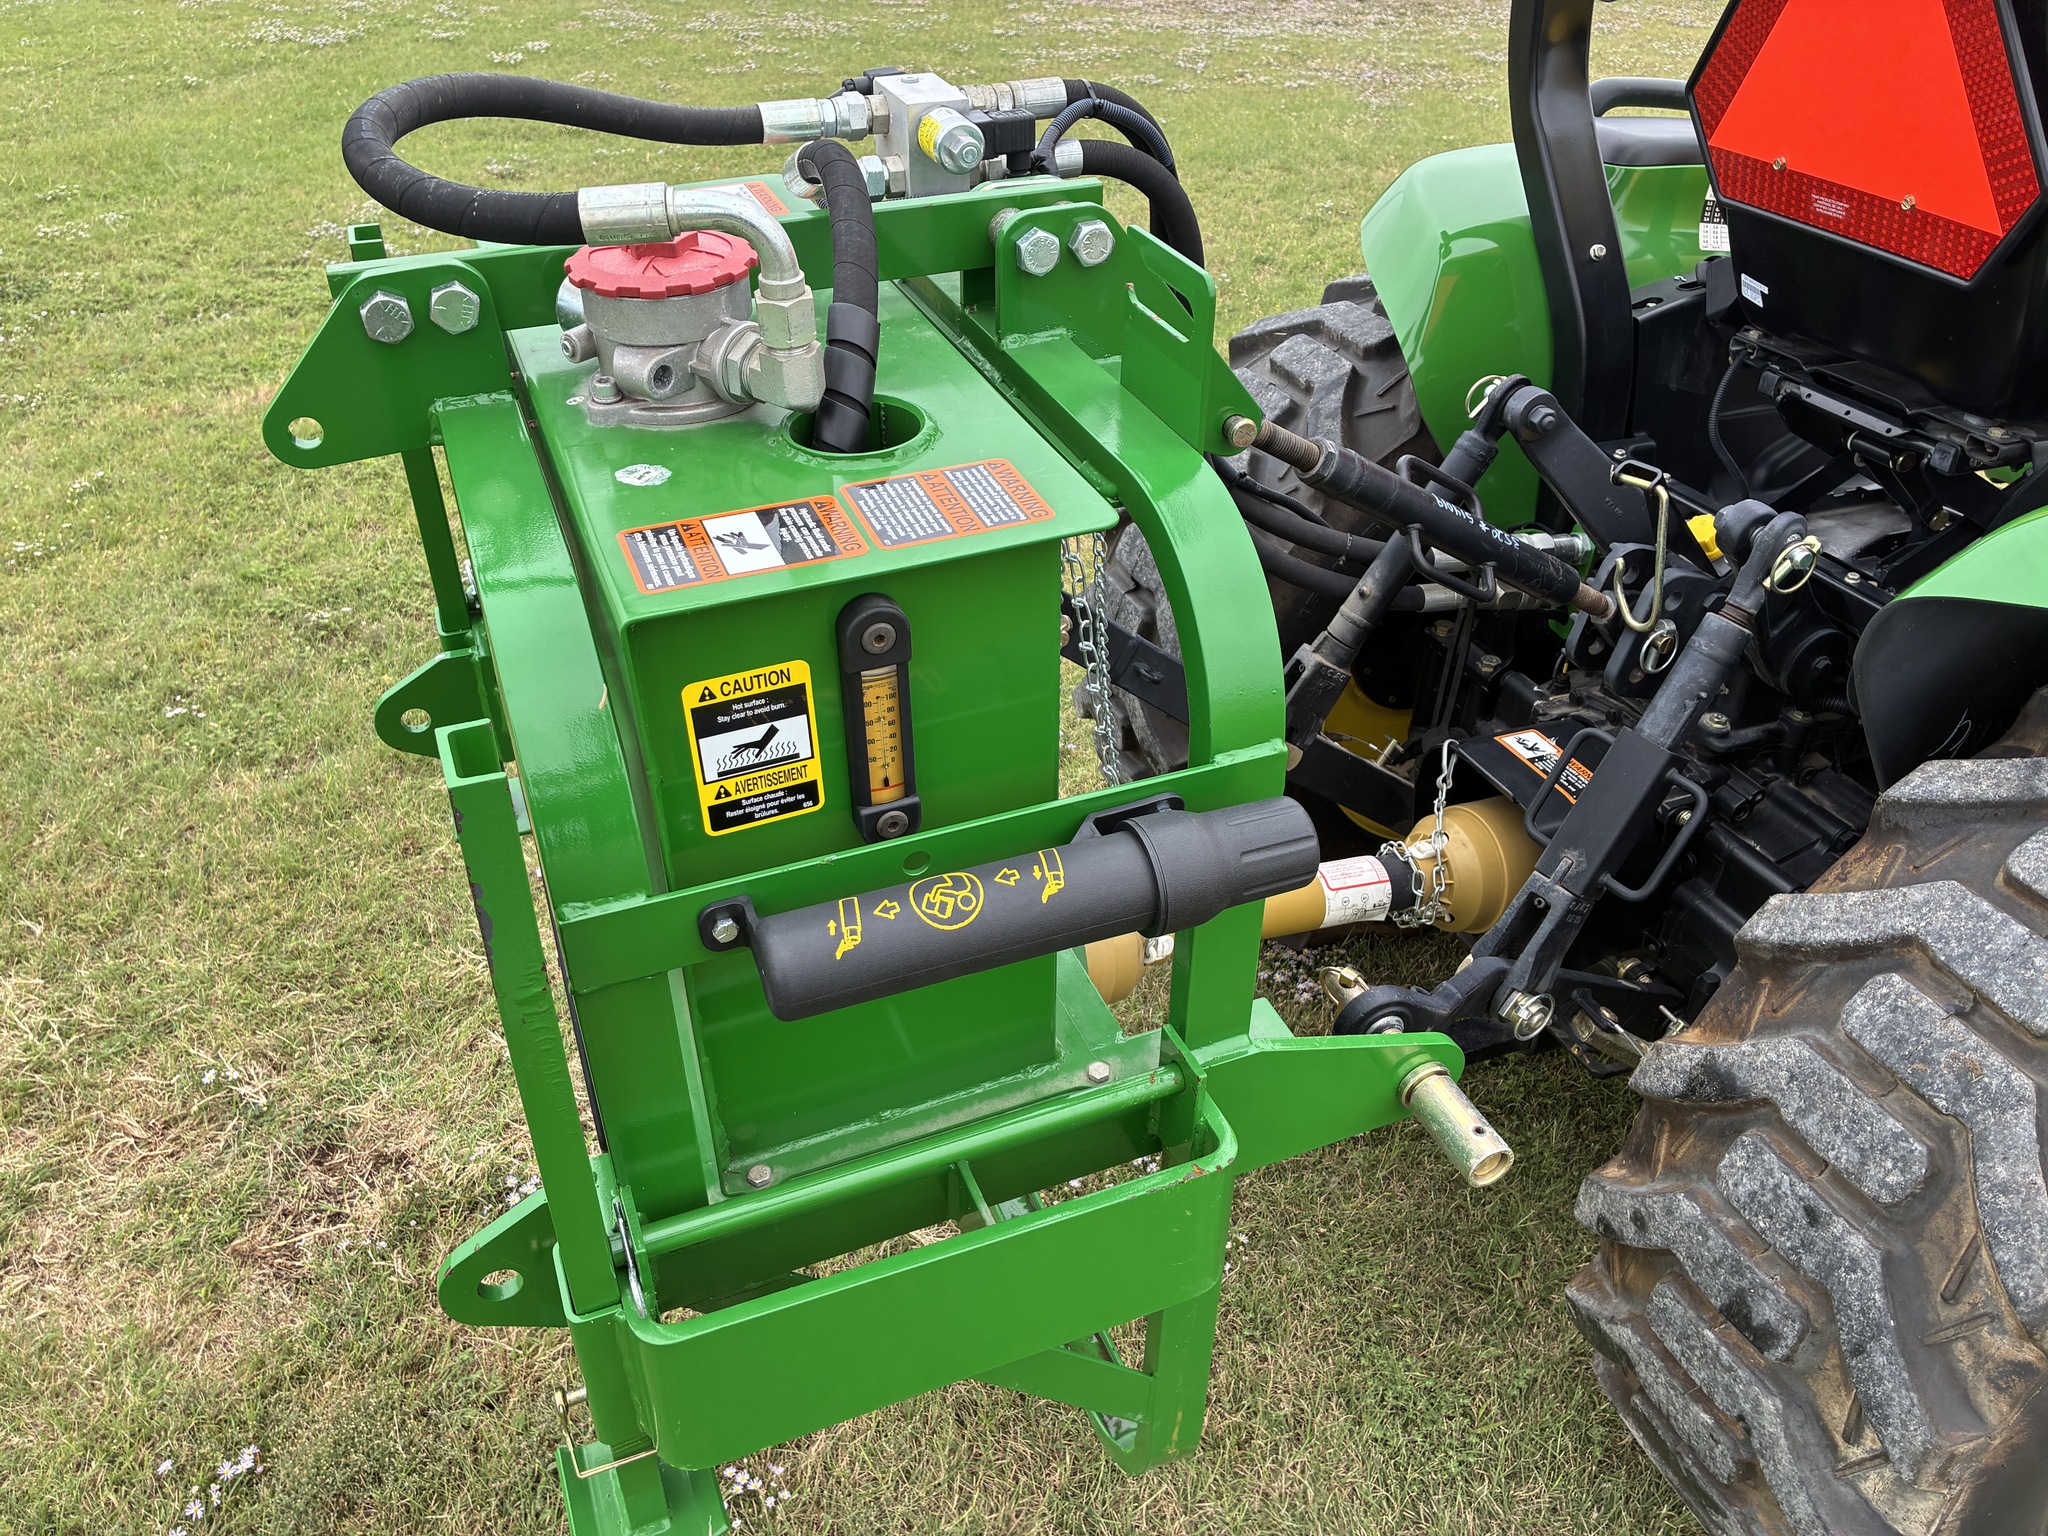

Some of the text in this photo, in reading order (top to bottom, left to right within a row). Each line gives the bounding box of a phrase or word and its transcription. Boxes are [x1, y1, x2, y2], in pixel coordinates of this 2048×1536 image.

[994, 468, 1050, 518] WARNING
[926, 480, 980, 532] ATTENTION
[818, 506, 862, 551] WARNING
[684, 530, 722, 579] ATTENTION
[720, 668, 791, 696] CAUTION
[732, 703, 743, 711] Hot
[744, 698, 765, 708] surface
[885, 692, 897, 701] 100
[717, 715, 730, 723] Stay
[731, 711, 746, 719] clear
[754, 705, 770, 714] avoid
[735, 765, 808, 795] AVERTISSEMENT
[726, 809, 744, 818] Rester
[745, 804, 766, 813] éloigné
[781, 796, 796, 805] éviter
[742, 796, 763, 806] Surface
[764, 791, 784, 801] chaude
[755, 809, 779, 818] brûlures.
